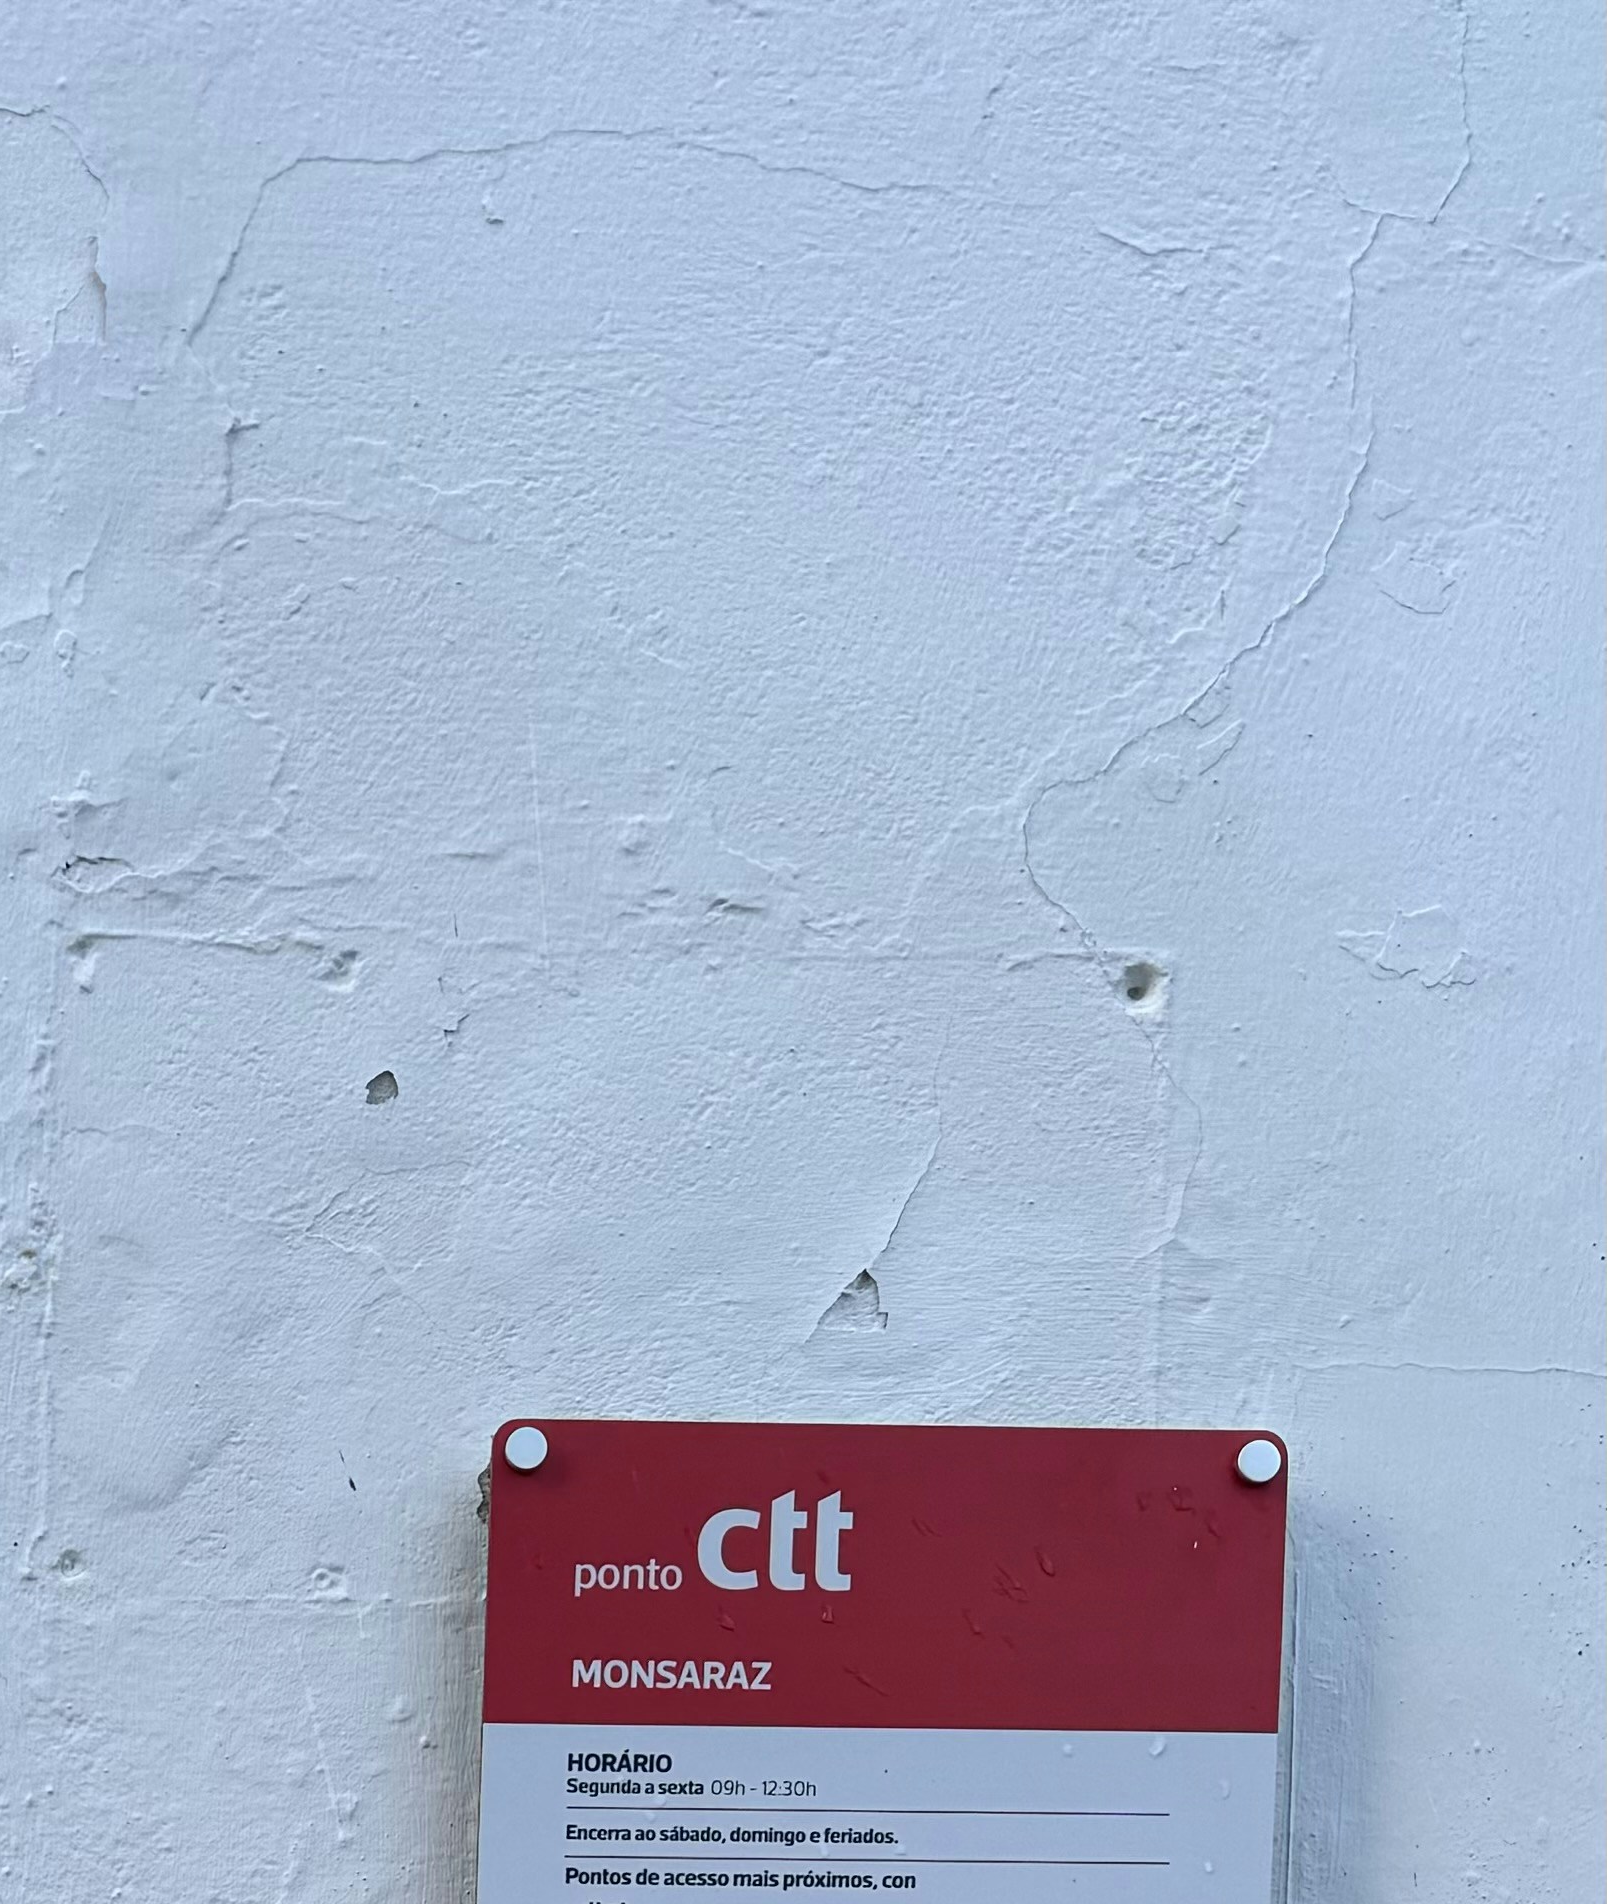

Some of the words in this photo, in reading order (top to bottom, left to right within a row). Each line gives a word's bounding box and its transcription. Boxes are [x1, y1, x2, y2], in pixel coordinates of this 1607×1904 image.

[574, 1558, 683, 1597] ponto
[697, 1489, 854, 1592] ctt
[572, 1658, 772, 1690] MONSARAZ
[567, 1750, 673, 1773] HORÁRIO
[566, 1778, 641, 1797] Segunda
[644, 1783, 655, 1795] a
[658, 1781, 704, 1795] sexta
[711, 1780, 745, 1796] 09h
[762, 1781, 817, 1797] 12:30h
[566, 1825, 631, 1842] Encerra
[635, 1829, 656, 1842] ao
[659, 1825, 727, 1844] sábado,
[730, 1826, 806, 1846] domingo
[810, 1831, 821, 1844] e
[824, 1827, 899, 1845] feriados.
[565, 1867, 631, 1886] Pontos
[635, 1868, 660, 1886] de
[664, 1872, 729, 1887] acesso
[733, 1870, 779, 1887] mais
[783, 1871, 877, 1890] próximos,
[882, 1875, 916, 1889] con
